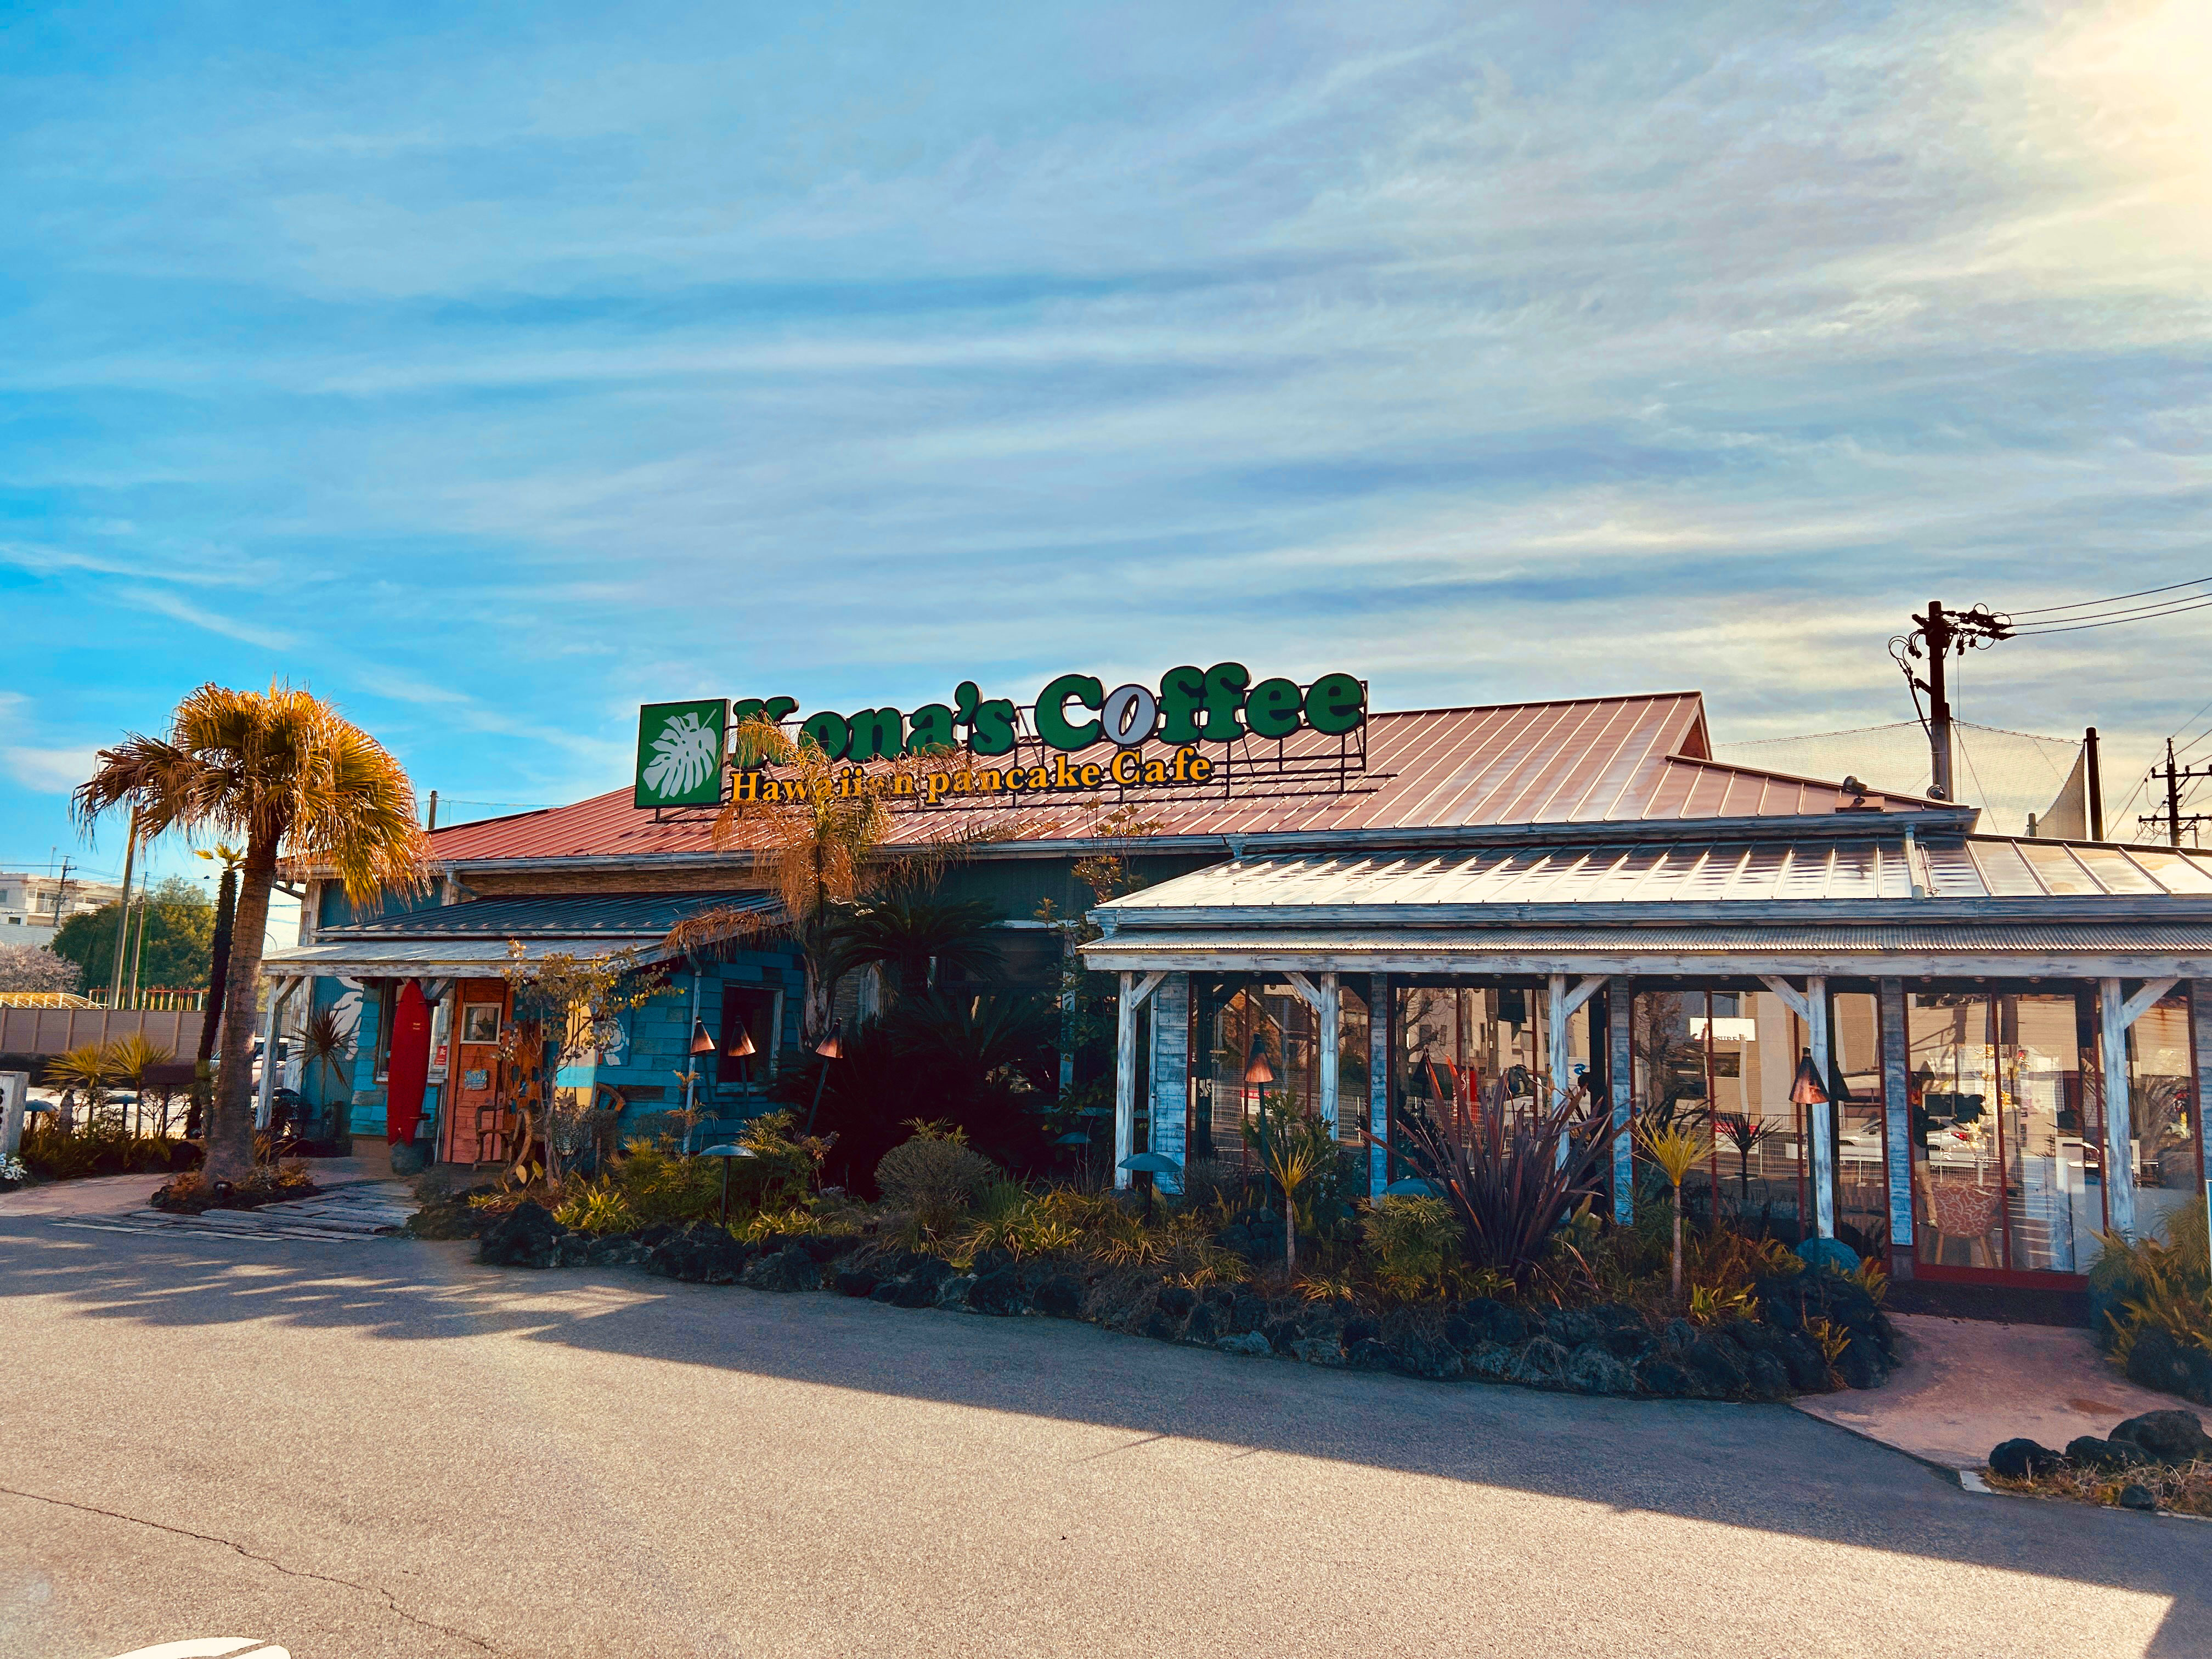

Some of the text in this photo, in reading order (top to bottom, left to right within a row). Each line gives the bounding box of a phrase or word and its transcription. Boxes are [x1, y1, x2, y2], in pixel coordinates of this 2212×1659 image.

[732, 662, 1364, 769] Kona's Coffee
[924, 754, 1101, 804] pancake
[1111, 747, 1212, 785] Cafe
